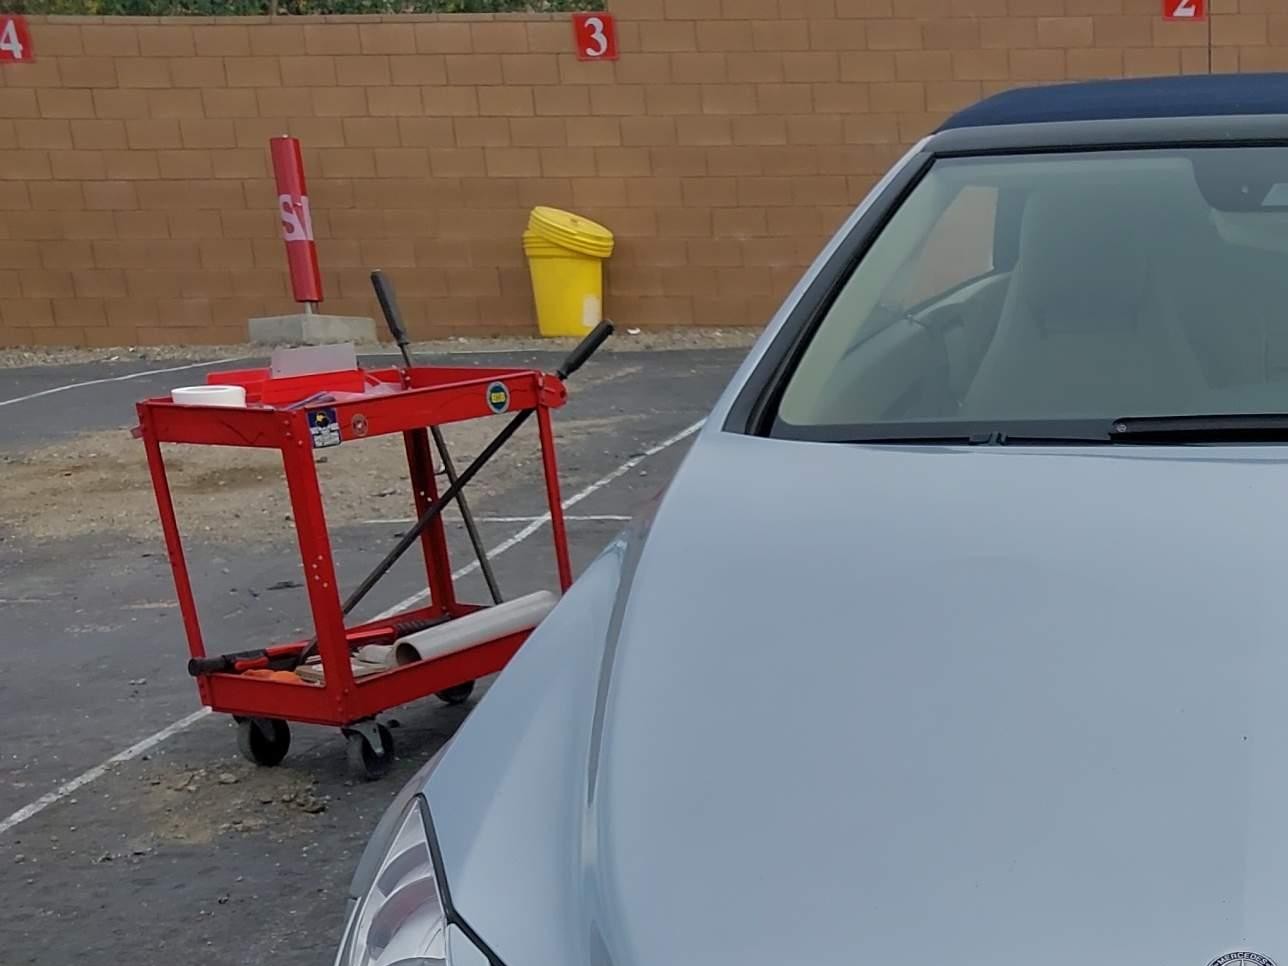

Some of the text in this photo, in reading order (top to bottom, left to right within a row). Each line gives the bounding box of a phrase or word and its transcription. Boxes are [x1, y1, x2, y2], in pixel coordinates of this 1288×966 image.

[0, 19, 24, 59] 4
[584, 17, 608, 57] 3
[1217, 952, 1268, 965] MERCEDES
